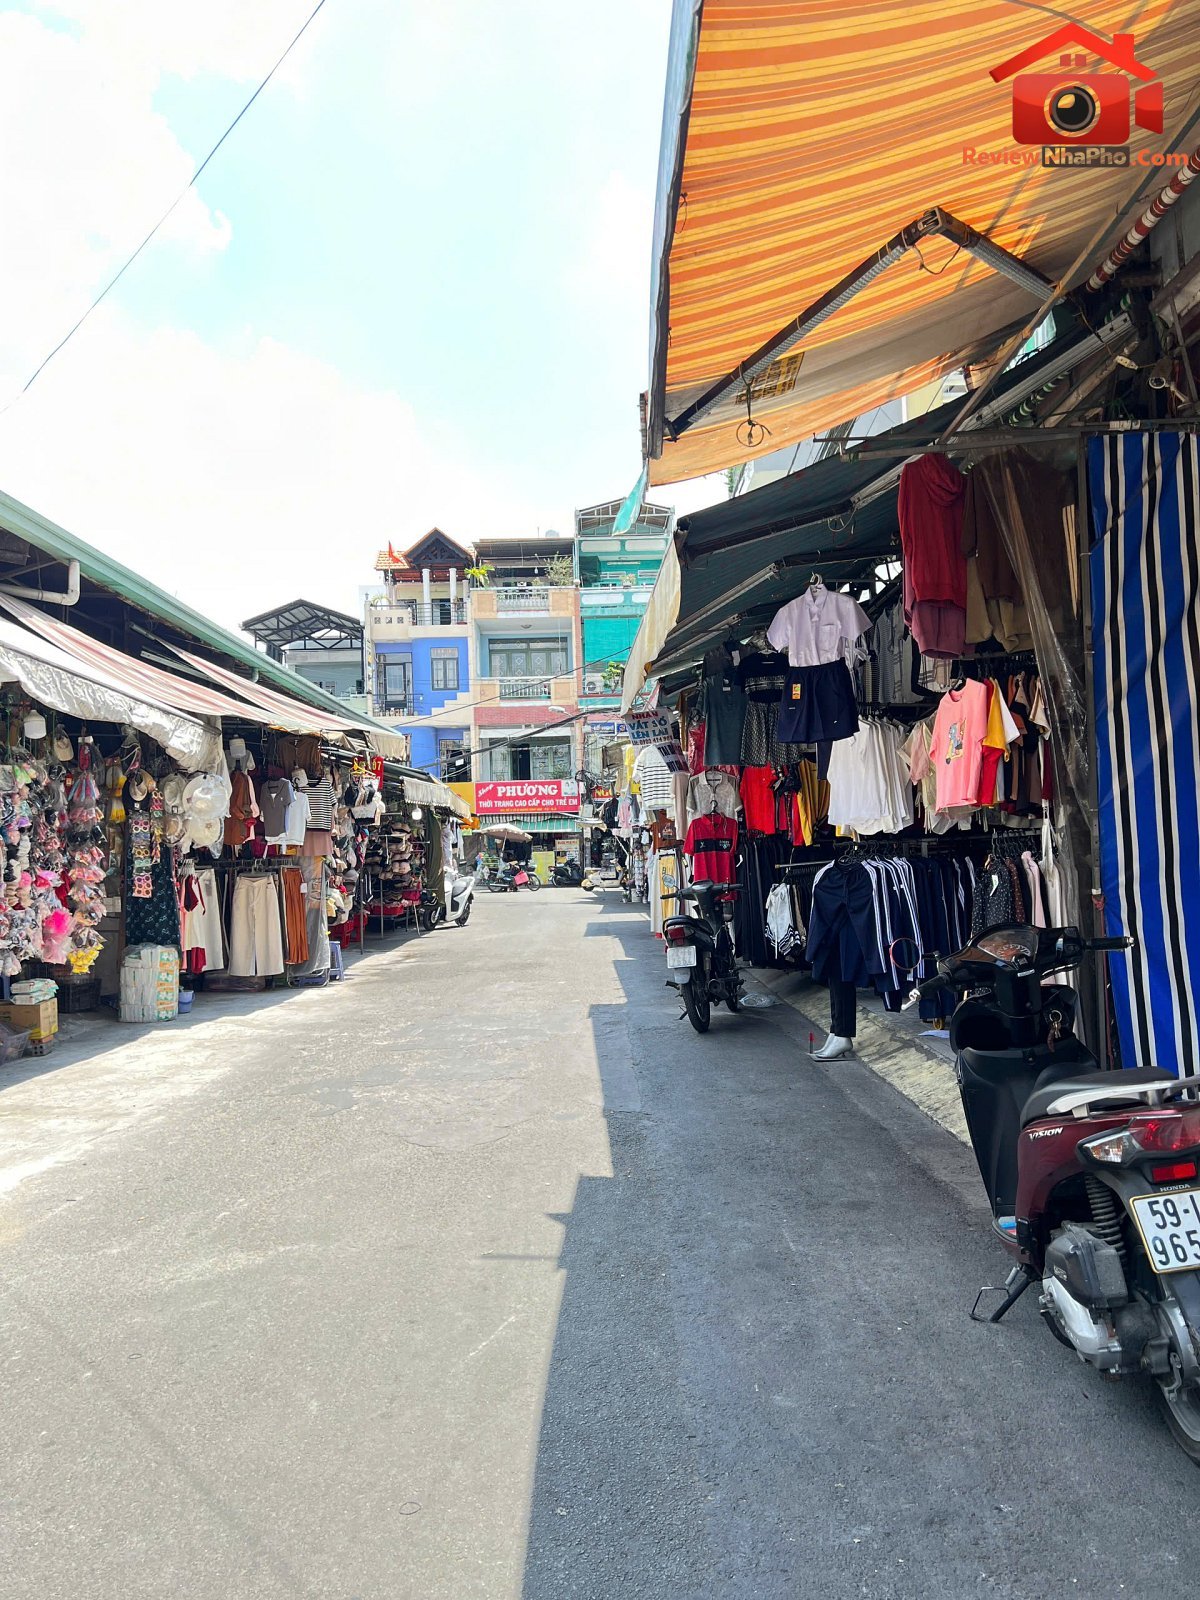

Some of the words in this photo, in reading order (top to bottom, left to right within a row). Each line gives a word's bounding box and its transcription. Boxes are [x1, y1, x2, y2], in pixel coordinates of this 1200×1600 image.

[478, 784, 494, 798] Shop
[497, 783, 558, 797] PHƯƠNG
[479, 798, 492, 808] THỜI
[528, 797, 540, 806] CẤP
[1029, 1127, 1064, 1141] VISION
[1160, 1184, 1191, 1192] HONDA
